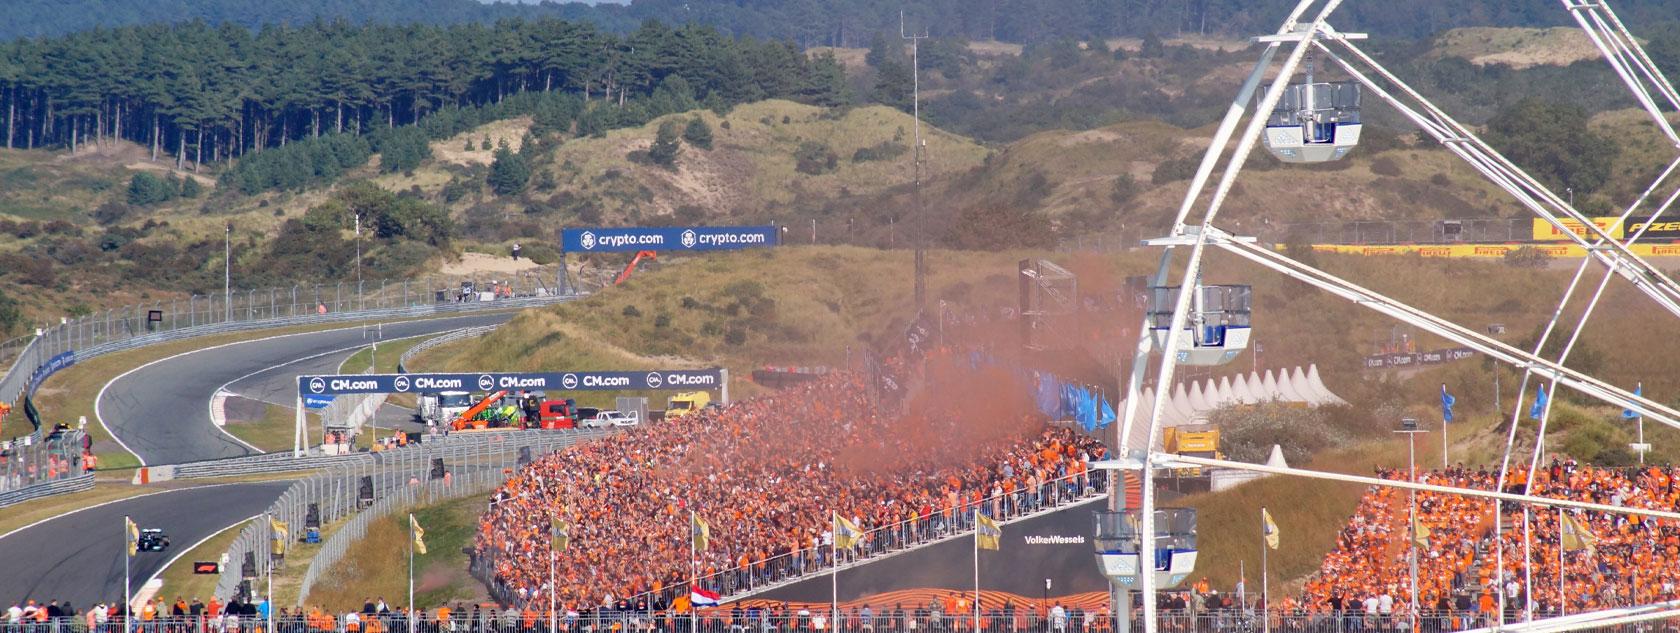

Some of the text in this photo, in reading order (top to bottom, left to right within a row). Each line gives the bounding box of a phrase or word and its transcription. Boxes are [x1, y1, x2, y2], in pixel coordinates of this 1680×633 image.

[598, 233, 664, 247] crypto.com
[699, 232, 765, 246] crypto.com
[331, 379, 378, 390] CM.com
[414, 378, 462, 389] CM.com
[499, 376, 546, 387] CM.com
[583, 375, 630, 386] CM.com
[667, 374, 714, 385] CM.com
[1024, 535, 1085, 544] VolkerWessels
